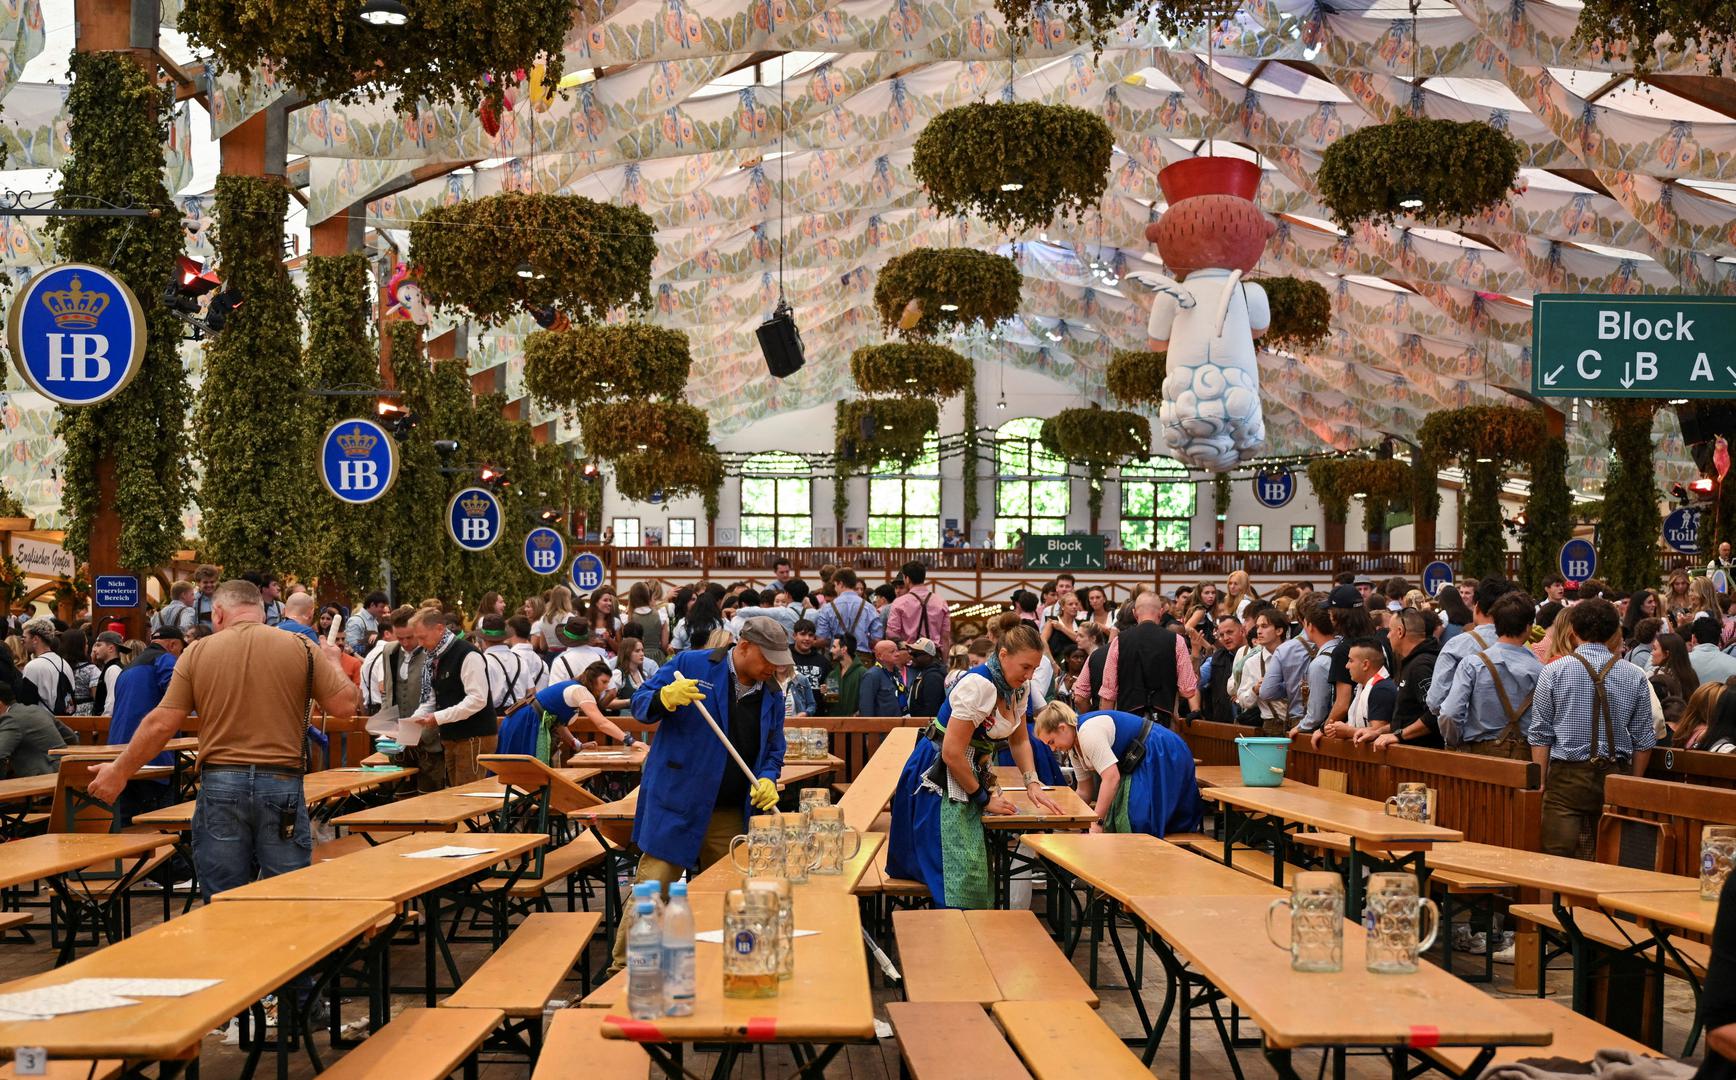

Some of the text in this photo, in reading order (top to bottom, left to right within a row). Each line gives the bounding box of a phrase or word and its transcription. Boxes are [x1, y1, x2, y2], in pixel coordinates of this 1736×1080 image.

[1598, 310, 1695, 341] Block
[46, 333, 111, 382] HB
[1576, 349, 1715, 382] C B A
[338, 460, 379, 490] HB
[1264, 483, 1285, 500] HB
[461, 518, 490, 541] HB
[1047, 539, 1082, 551] Block
[533, 550, 556, 568] HB
[1039, 553, 1049, 565] K
[1065, 553, 1071, 565] J
[1568, 560, 1589, 577] HB
[579, 572, 598, 587] HB
[24, 1054, 36, 1069] 3
